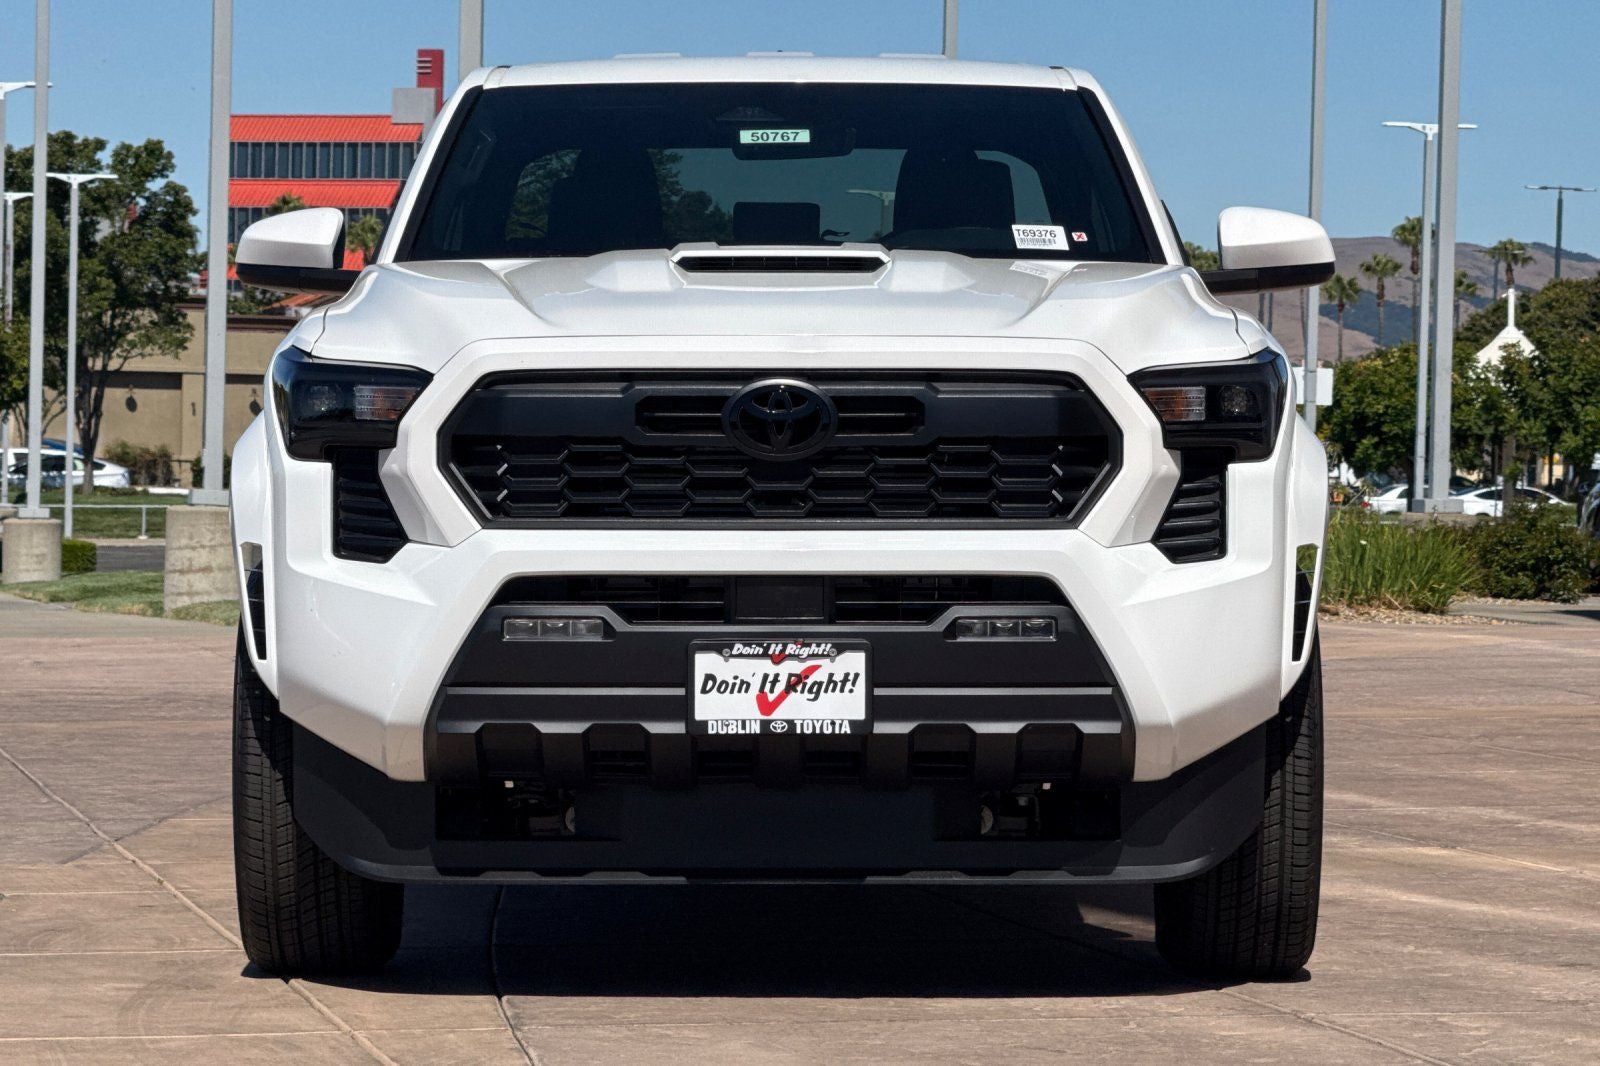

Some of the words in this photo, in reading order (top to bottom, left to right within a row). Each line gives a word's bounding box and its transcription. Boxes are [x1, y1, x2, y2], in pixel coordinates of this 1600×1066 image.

[751, 131, 800, 142] 50767
[1015, 228, 1057, 239] T69376
[768, 643, 783, 655] It
[785, 643, 832, 658] Right!
[700, 672, 756, 695] Doin'
[758, 672, 780, 694] It
[784, 672, 860, 702] Right!
[707, 720, 761, 734] DUBLIN
[794, 720, 850, 734] TOYOTA
